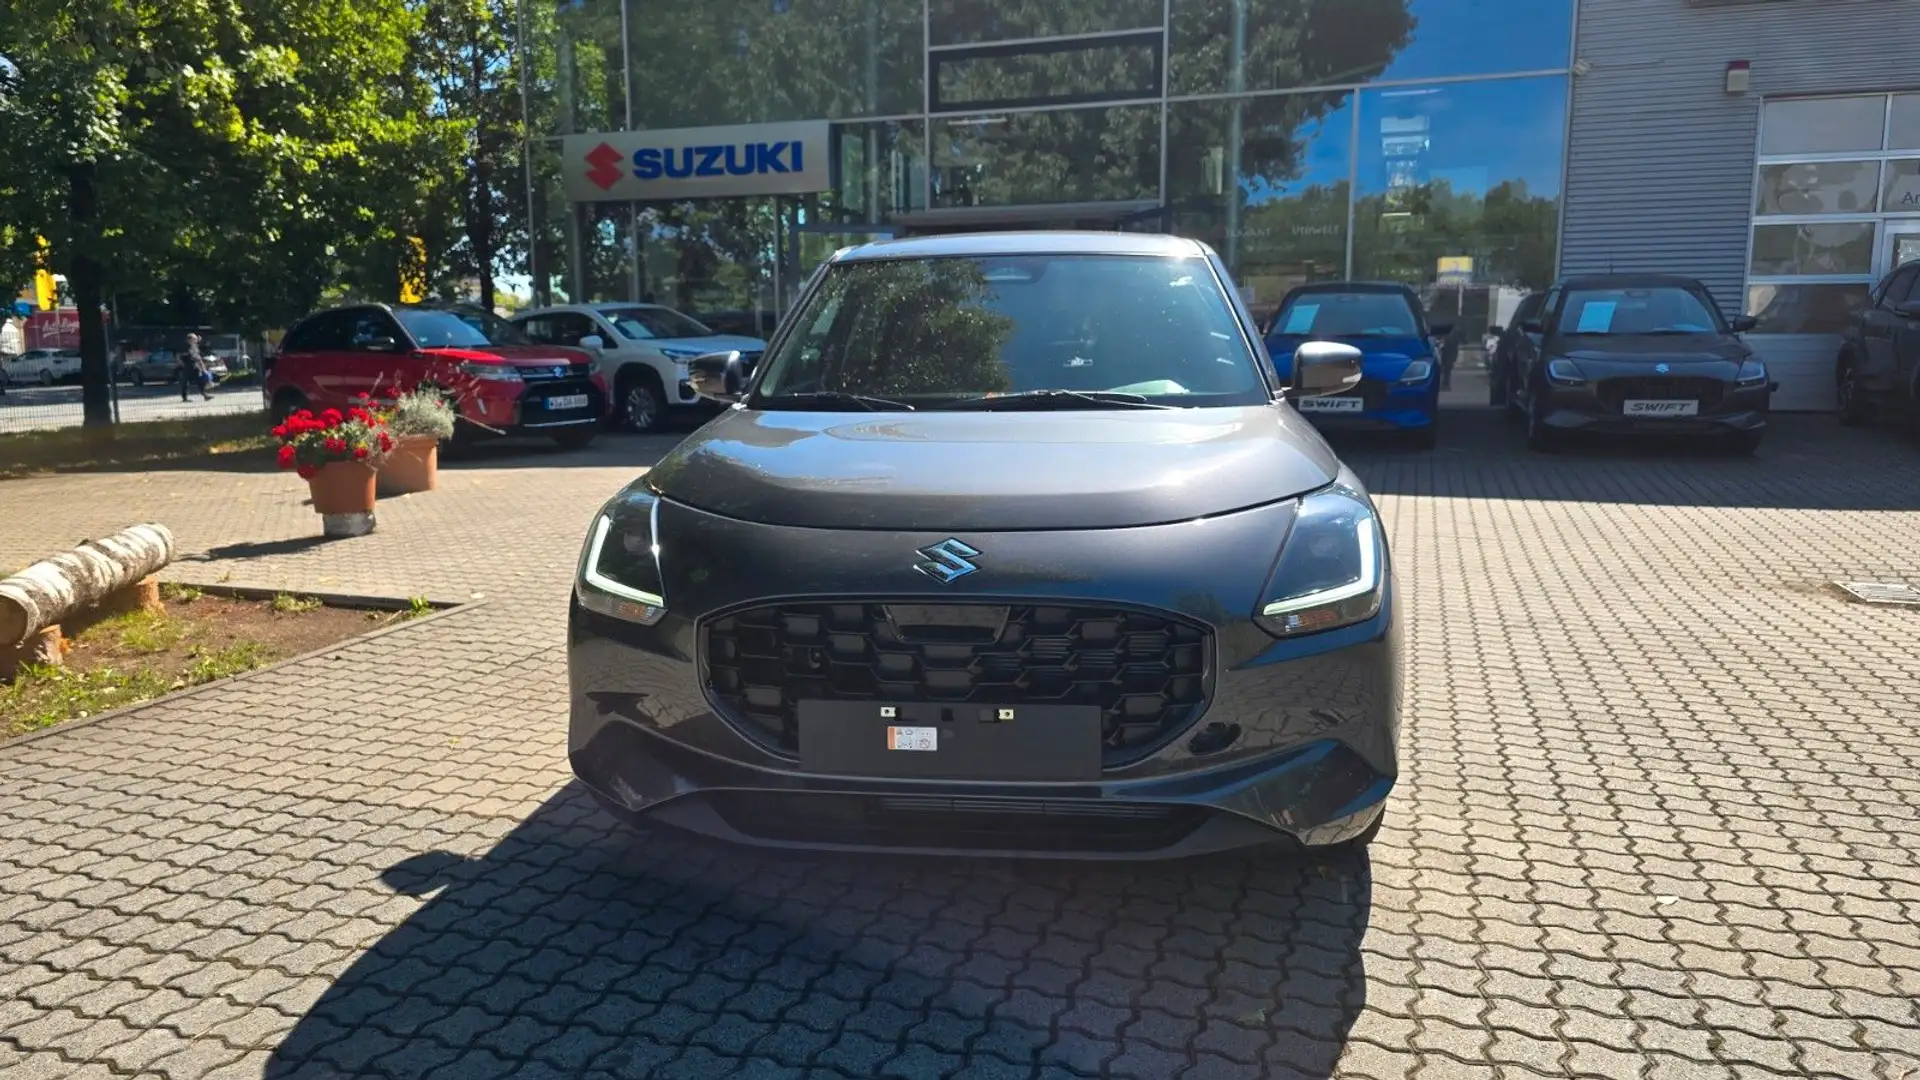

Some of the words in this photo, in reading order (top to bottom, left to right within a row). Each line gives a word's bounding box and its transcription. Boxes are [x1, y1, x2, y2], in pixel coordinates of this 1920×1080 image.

[632, 140, 803, 179] SUZUKI
[1302, 399, 1361, 409] SWIFT
[1631, 402, 1693, 412] SWIFT
